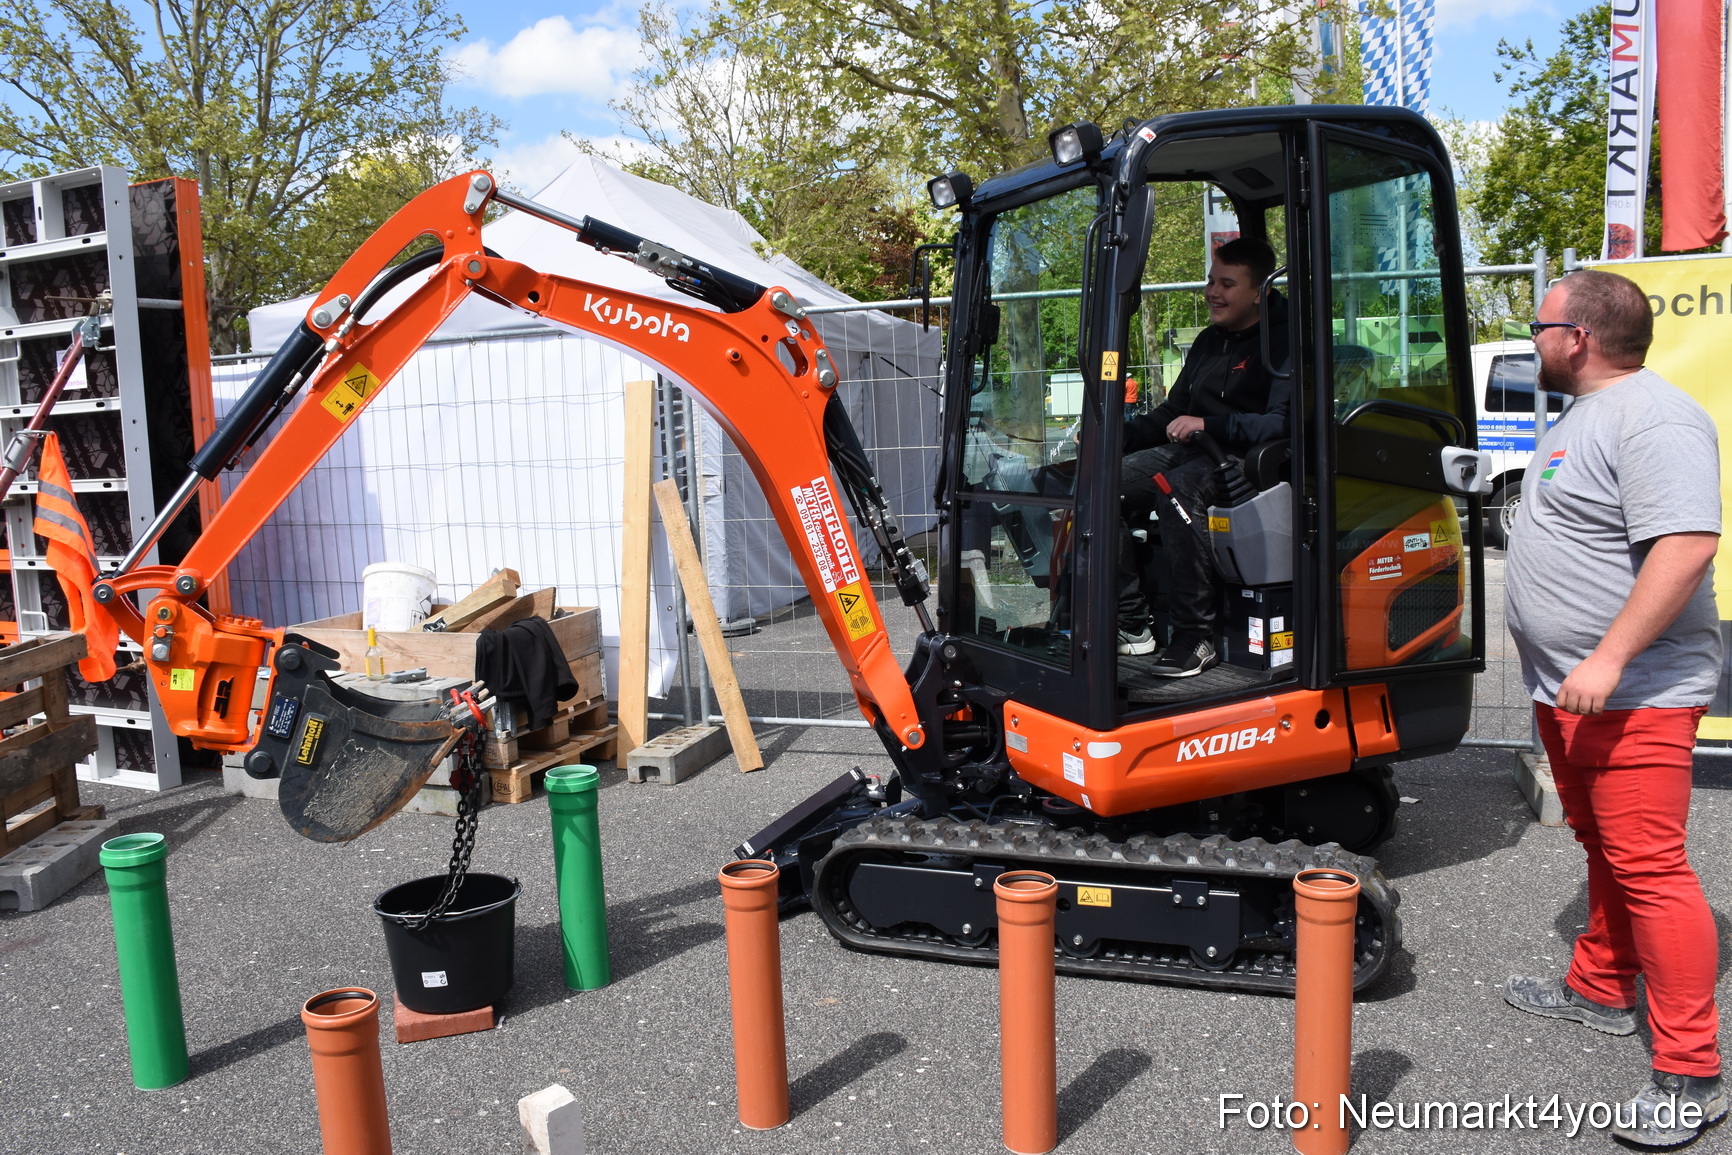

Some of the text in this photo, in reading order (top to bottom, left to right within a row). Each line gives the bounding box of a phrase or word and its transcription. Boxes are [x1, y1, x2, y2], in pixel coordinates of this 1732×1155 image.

[583, 293, 690, 342] Kubota
[799, 508, 815, 535] 09181
[812, 542, 824, 559] 232
[818, 559, 828, 572] 08
[801, 487, 836, 570] MEYER Fördertechnik
[814, 481, 858, 581] MIETFLOTTE
[1369, 564, 1402, 574] Fördertechnik
[1377, 556, 1394, 565] MEYER
